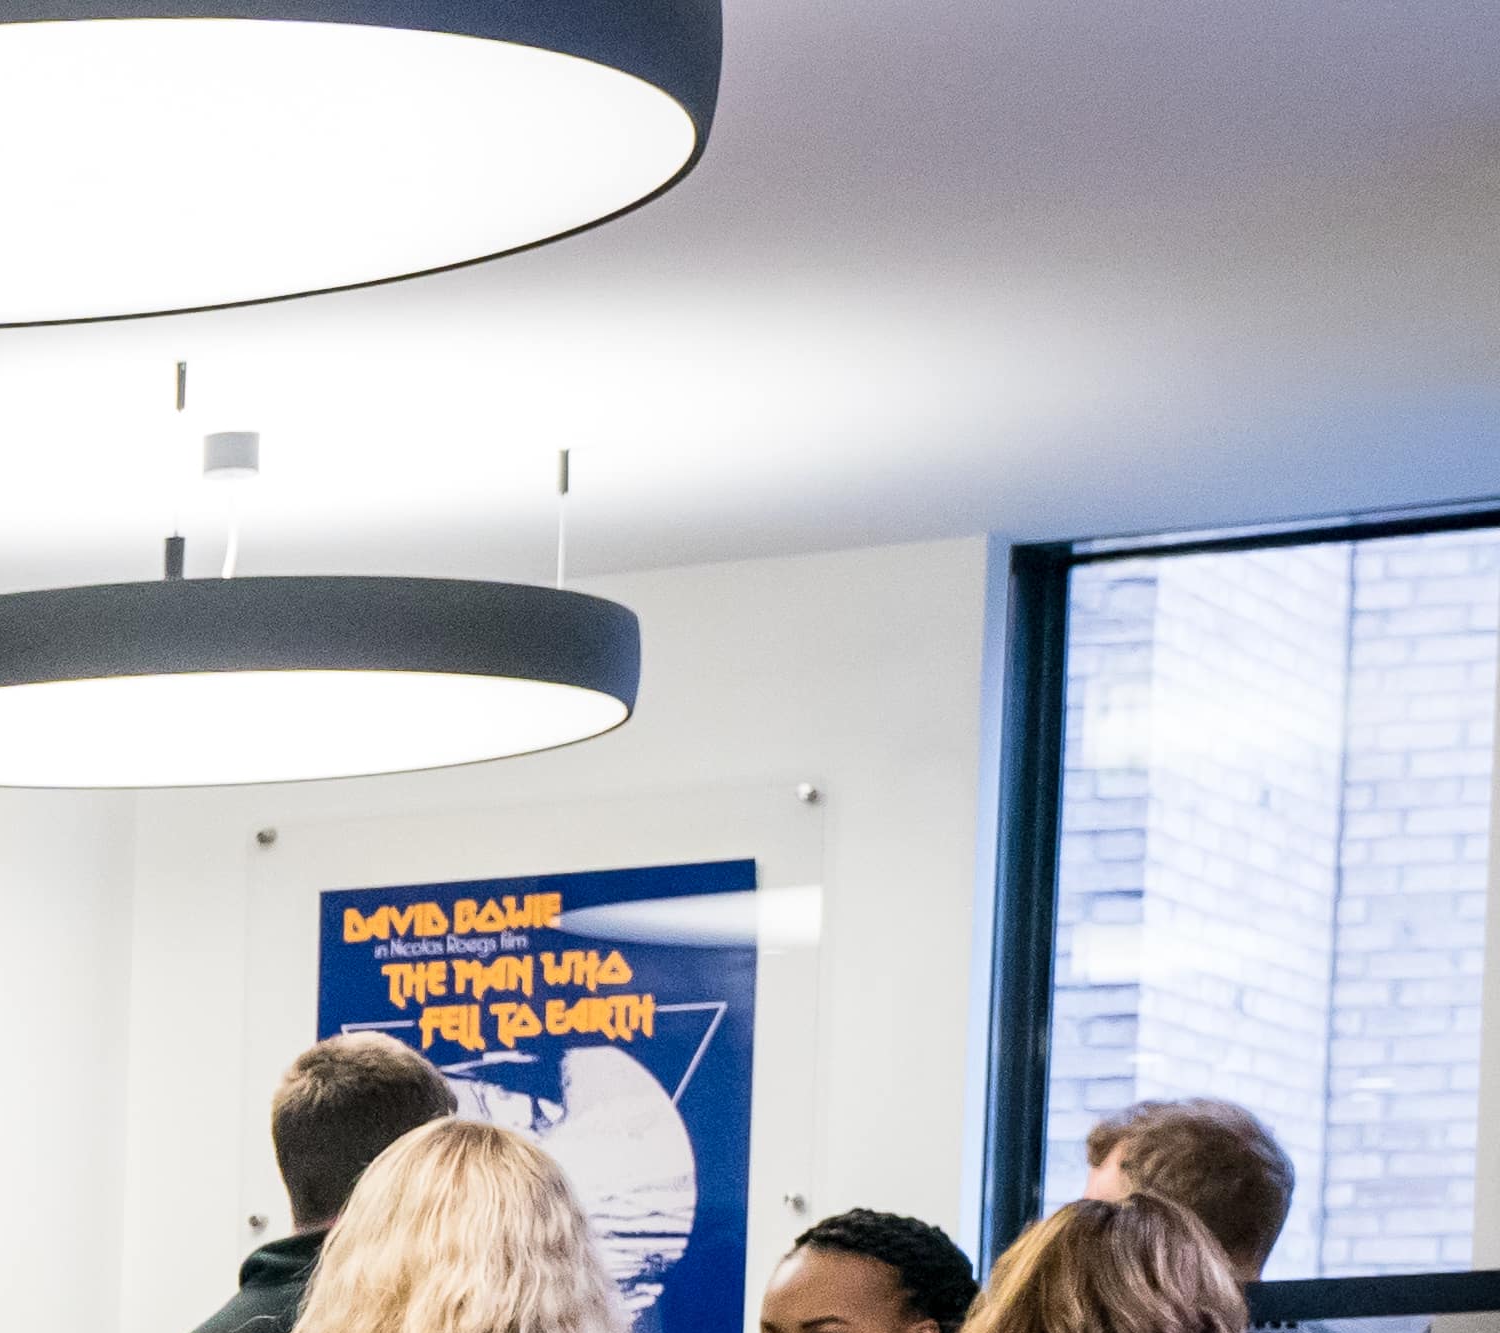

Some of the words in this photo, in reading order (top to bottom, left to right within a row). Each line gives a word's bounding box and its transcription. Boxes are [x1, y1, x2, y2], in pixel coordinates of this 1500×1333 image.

[343, 902, 449, 943] DAVID
[453, 892, 562, 934] BOWIE
[374, 944, 388, 959] in
[390, 939, 444, 958] Nicolas
[500, 930, 529, 950] film
[381, 960, 447, 1010] THE
[452, 955, 533, 1001] MAN
[540, 950, 633, 993] WHO
[419, 1003, 486, 1050] FELL
[489, 1001, 543, 1049] TO
[546, 994, 656, 1043] EARTH
